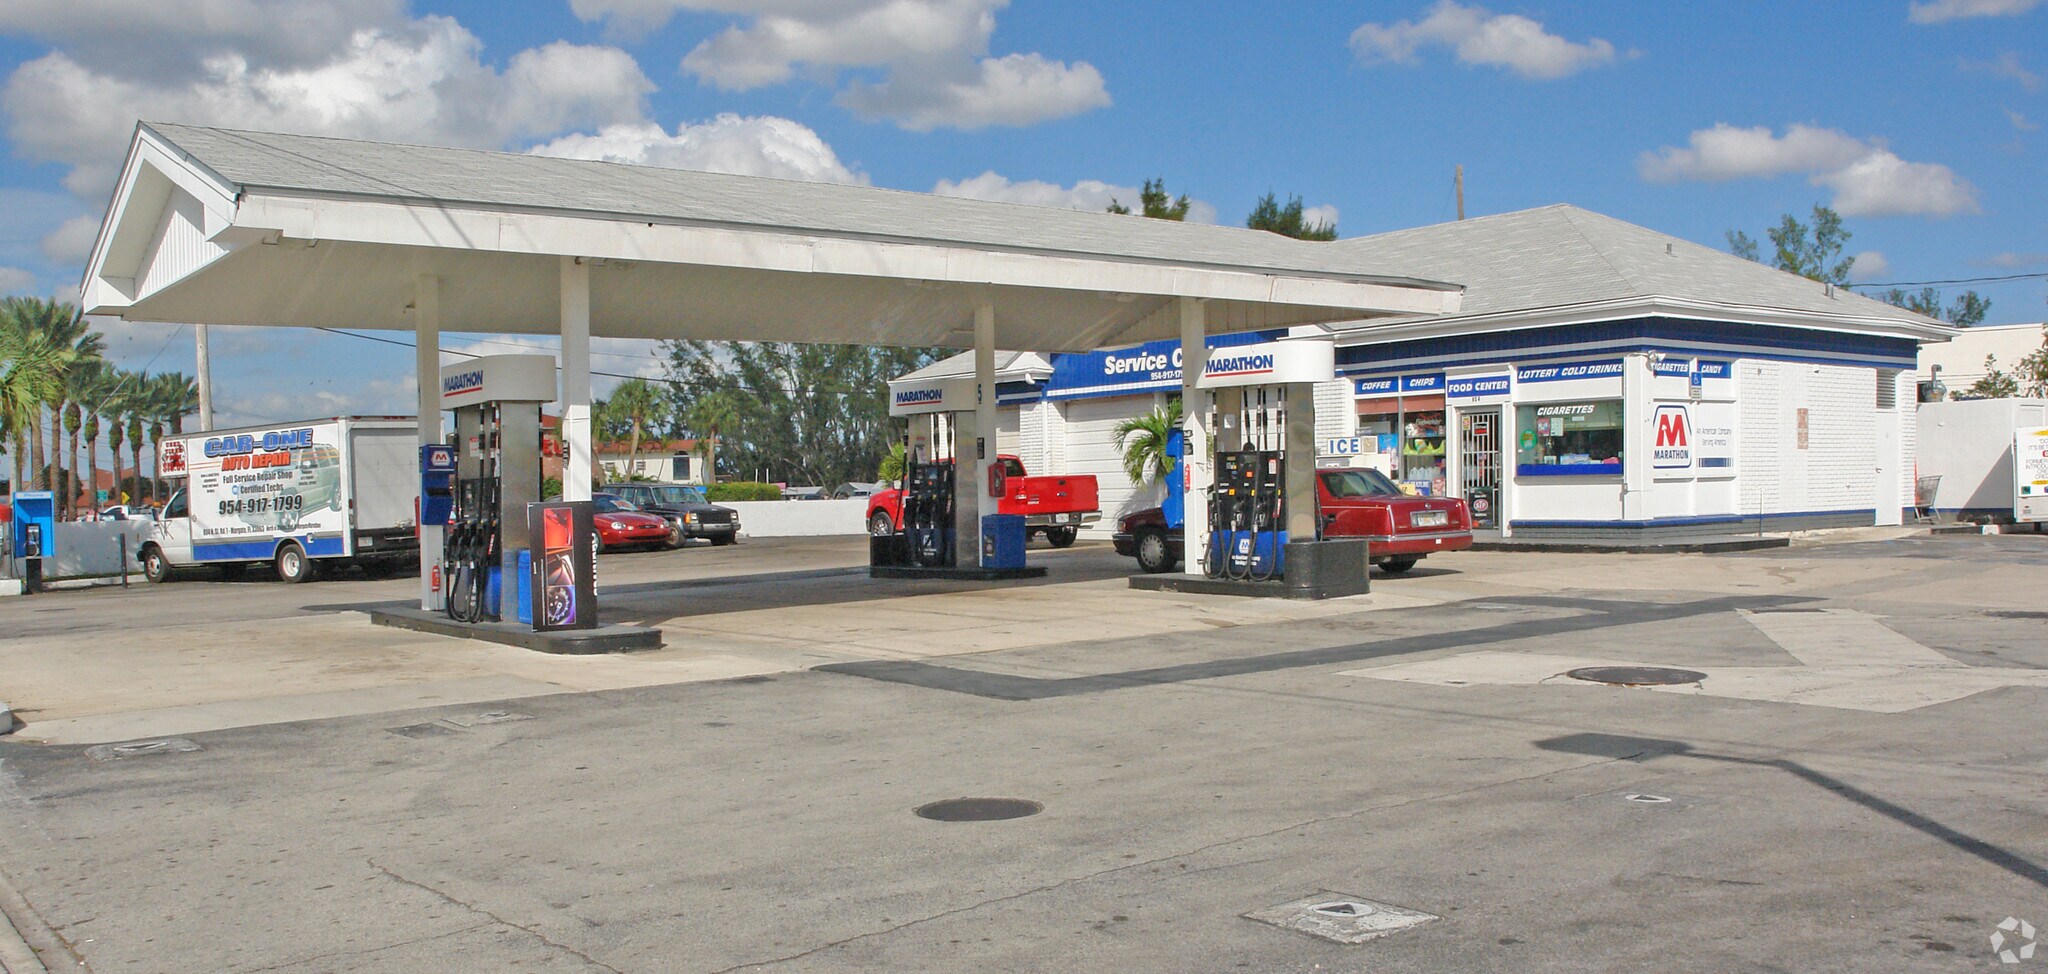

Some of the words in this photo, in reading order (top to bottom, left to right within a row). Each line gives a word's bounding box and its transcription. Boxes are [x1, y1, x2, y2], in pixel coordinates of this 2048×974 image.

[1104, 351, 1168, 375] Service
[1205, 354, 1274, 373] MARATHON
[1702, 364, 1724, 374] CANDY
[1518, 368, 1560, 380] LOTTERY
[1561, 366, 1586, 377] COLD
[1587, 363, 1623, 375] DRINKS
[443, 369, 484, 393] MARATHON
[1361, 381, 1392, 391] COFFEE
[1409, 377, 1435, 388] CHIPS
[1448, 383, 1473, 393] FOOD
[1475, 380, 1508, 391] CENTER
[896, 389, 943, 404] MARATHON
[1537, 404, 1595, 416] CIGARETTES
[1656, 414, 1687, 447] M
[205, 429, 313, 458] CAR-ONE
[1329, 438, 1359, 454] ICE
[221, 456, 251, 472] AUTO
[251, 451, 292, 469] REPAIR
[1653, 449, 1689, 460] MARATHON
[223, 475, 233, 484] Full
[234, 473, 256, 483] Service
[257, 472, 276, 482] Repair
[278, 470, 293, 480] Shop
[240, 485, 266, 495] Certified
[266, 483, 284, 493] Techs
[219, 495, 303, 515] 954-917-1799
